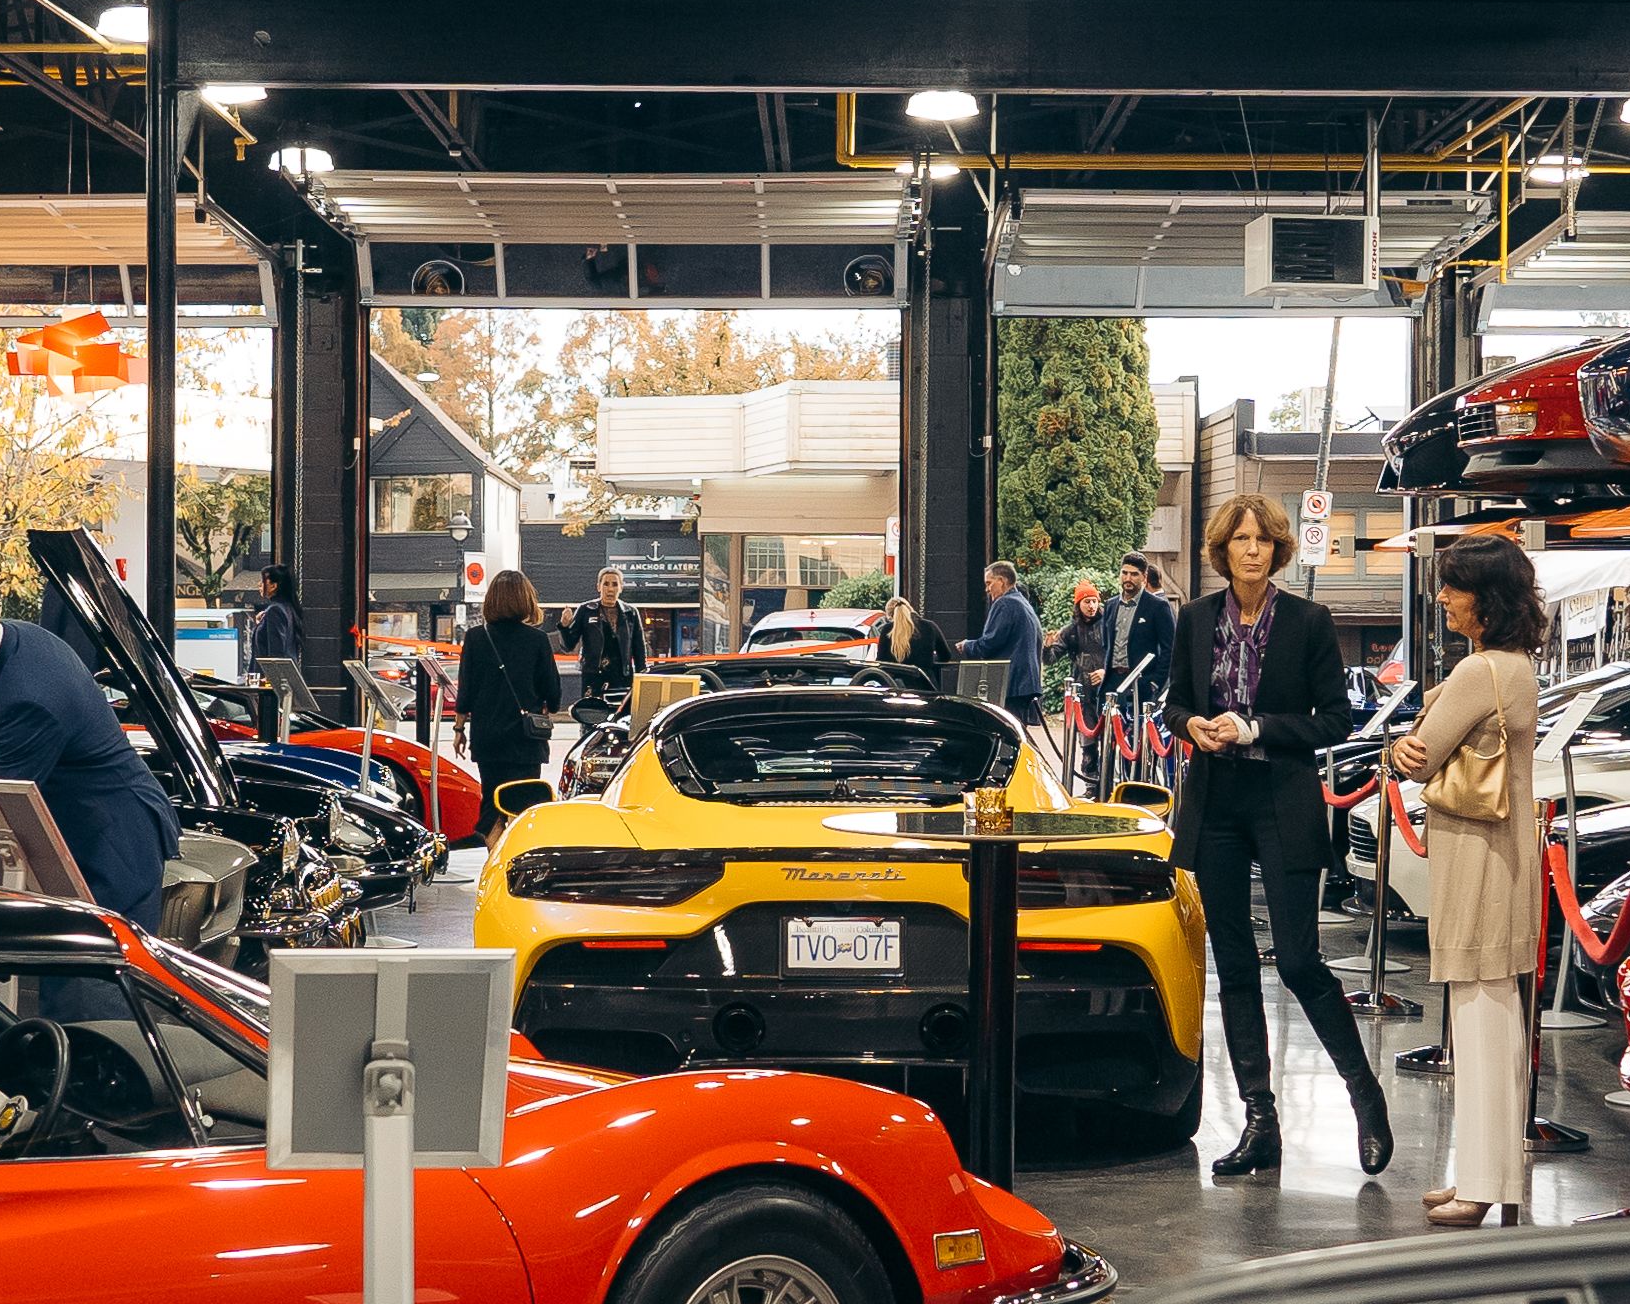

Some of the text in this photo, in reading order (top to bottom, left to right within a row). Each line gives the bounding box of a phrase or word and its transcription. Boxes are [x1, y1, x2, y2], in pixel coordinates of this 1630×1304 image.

[611, 563, 700, 572] THE ANCHOR EATERY
[781, 867, 907, 881] Maserati
